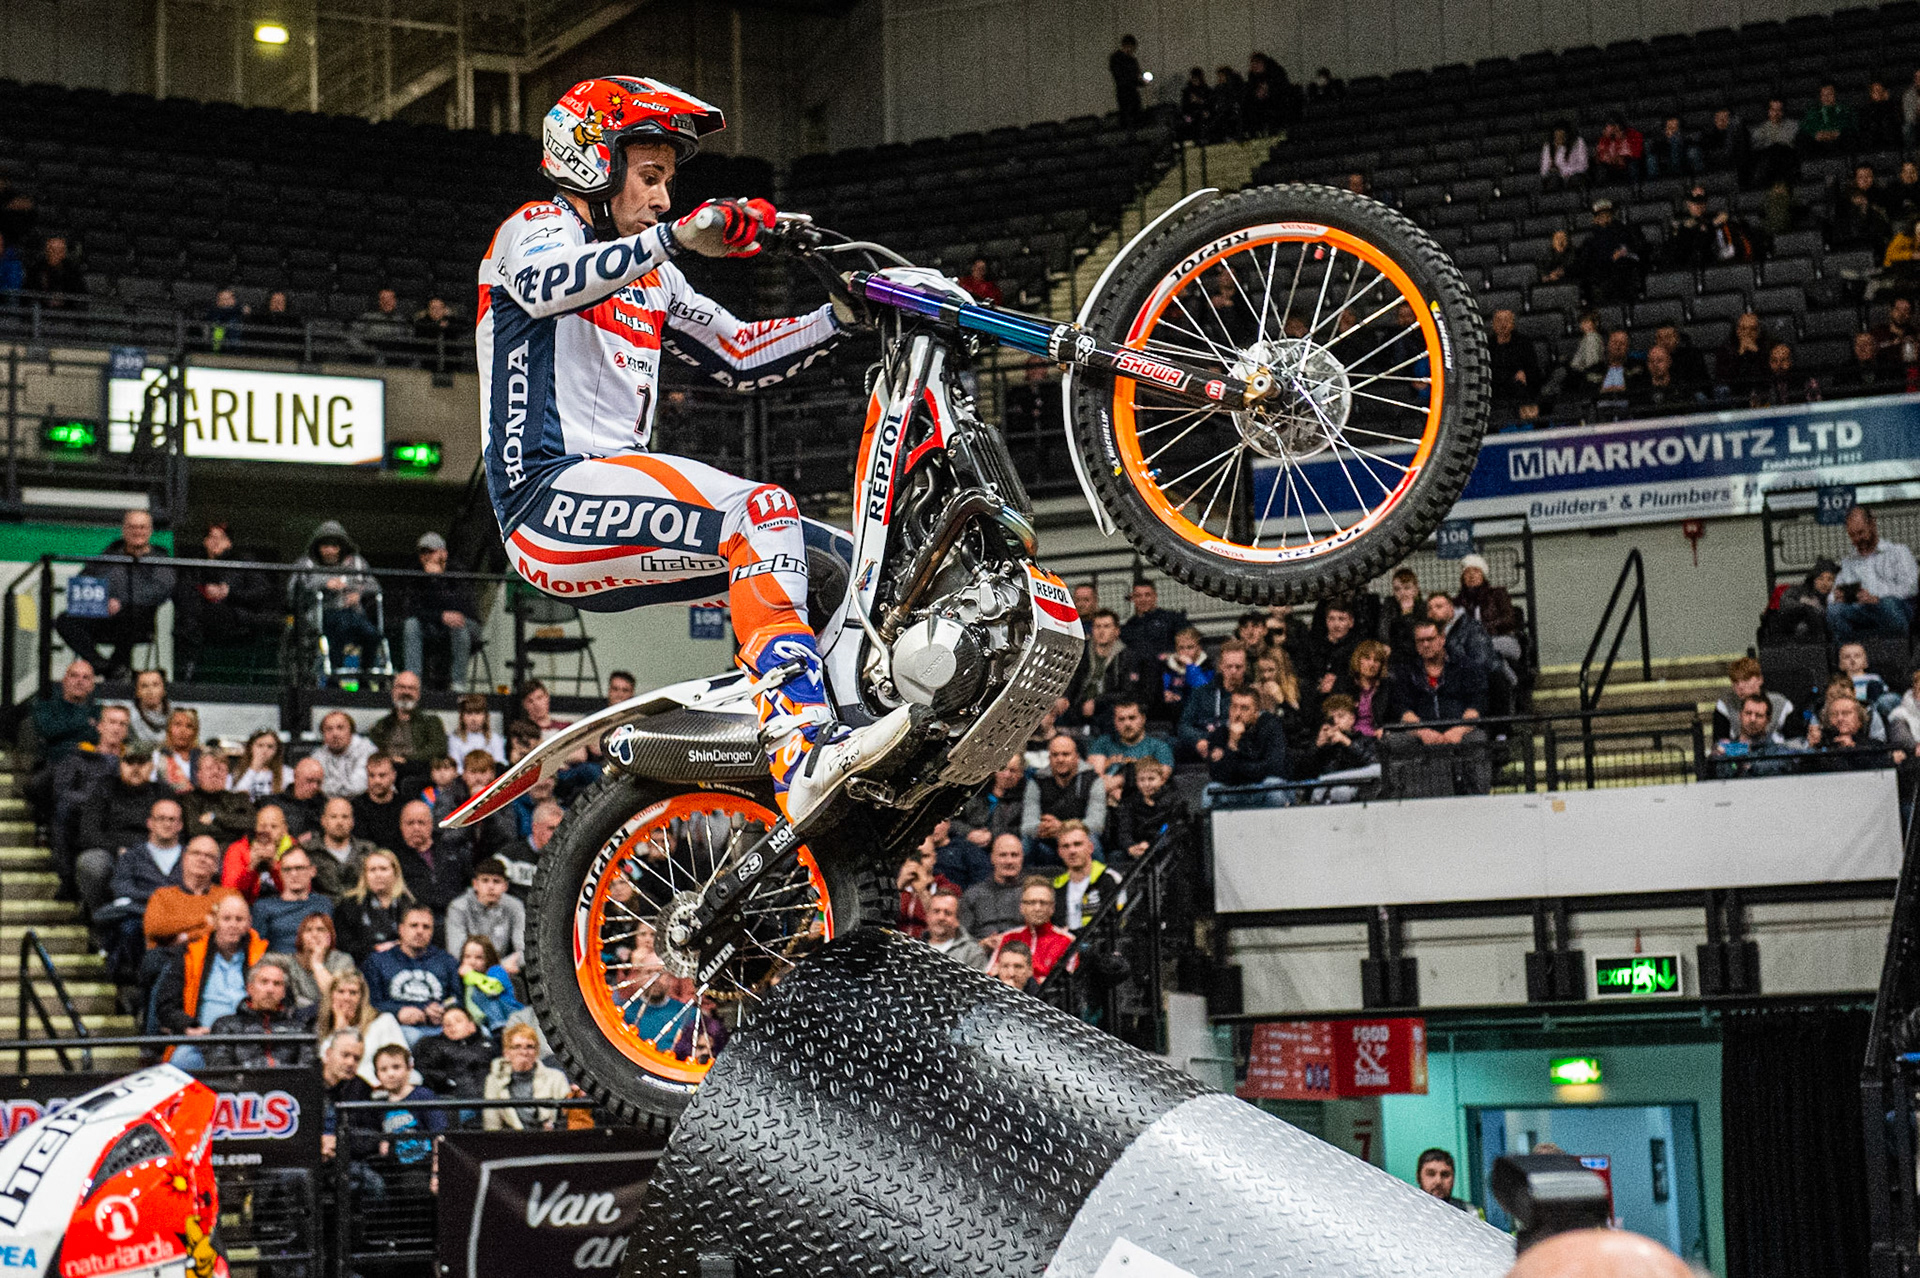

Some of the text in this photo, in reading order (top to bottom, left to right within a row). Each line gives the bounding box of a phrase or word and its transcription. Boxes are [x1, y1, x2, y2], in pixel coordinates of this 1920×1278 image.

[1116, 356, 1185, 386] SHOWA
[182, 388, 354, 448] ARLING
[504, 340, 529, 491] HONDA
[1545, 428, 1776, 477] MARKOVITZ
[1787, 420, 1863, 453] LTD
[869, 413, 903, 522] REPSOL
[1619, 495, 1633, 510] &
[543, 494, 703, 547] REPSOL
[757, 519, 798, 531] Montesa
[641, 556, 727, 572] hebo
[1210, 545, 1245, 559] HONDA
[1035, 582, 1069, 604] REPSOL
[688, 749, 752, 764] ShinDengen
[699, 942, 736, 983] GALFER
[1597, 968, 1632, 986] EXIT
[1353, 1025, 1390, 1042] FOOD
[212, 1096, 298, 1136] ALS
[526, 1181, 622, 1229] Van
[64, 1232, 175, 1278] naturlanda
